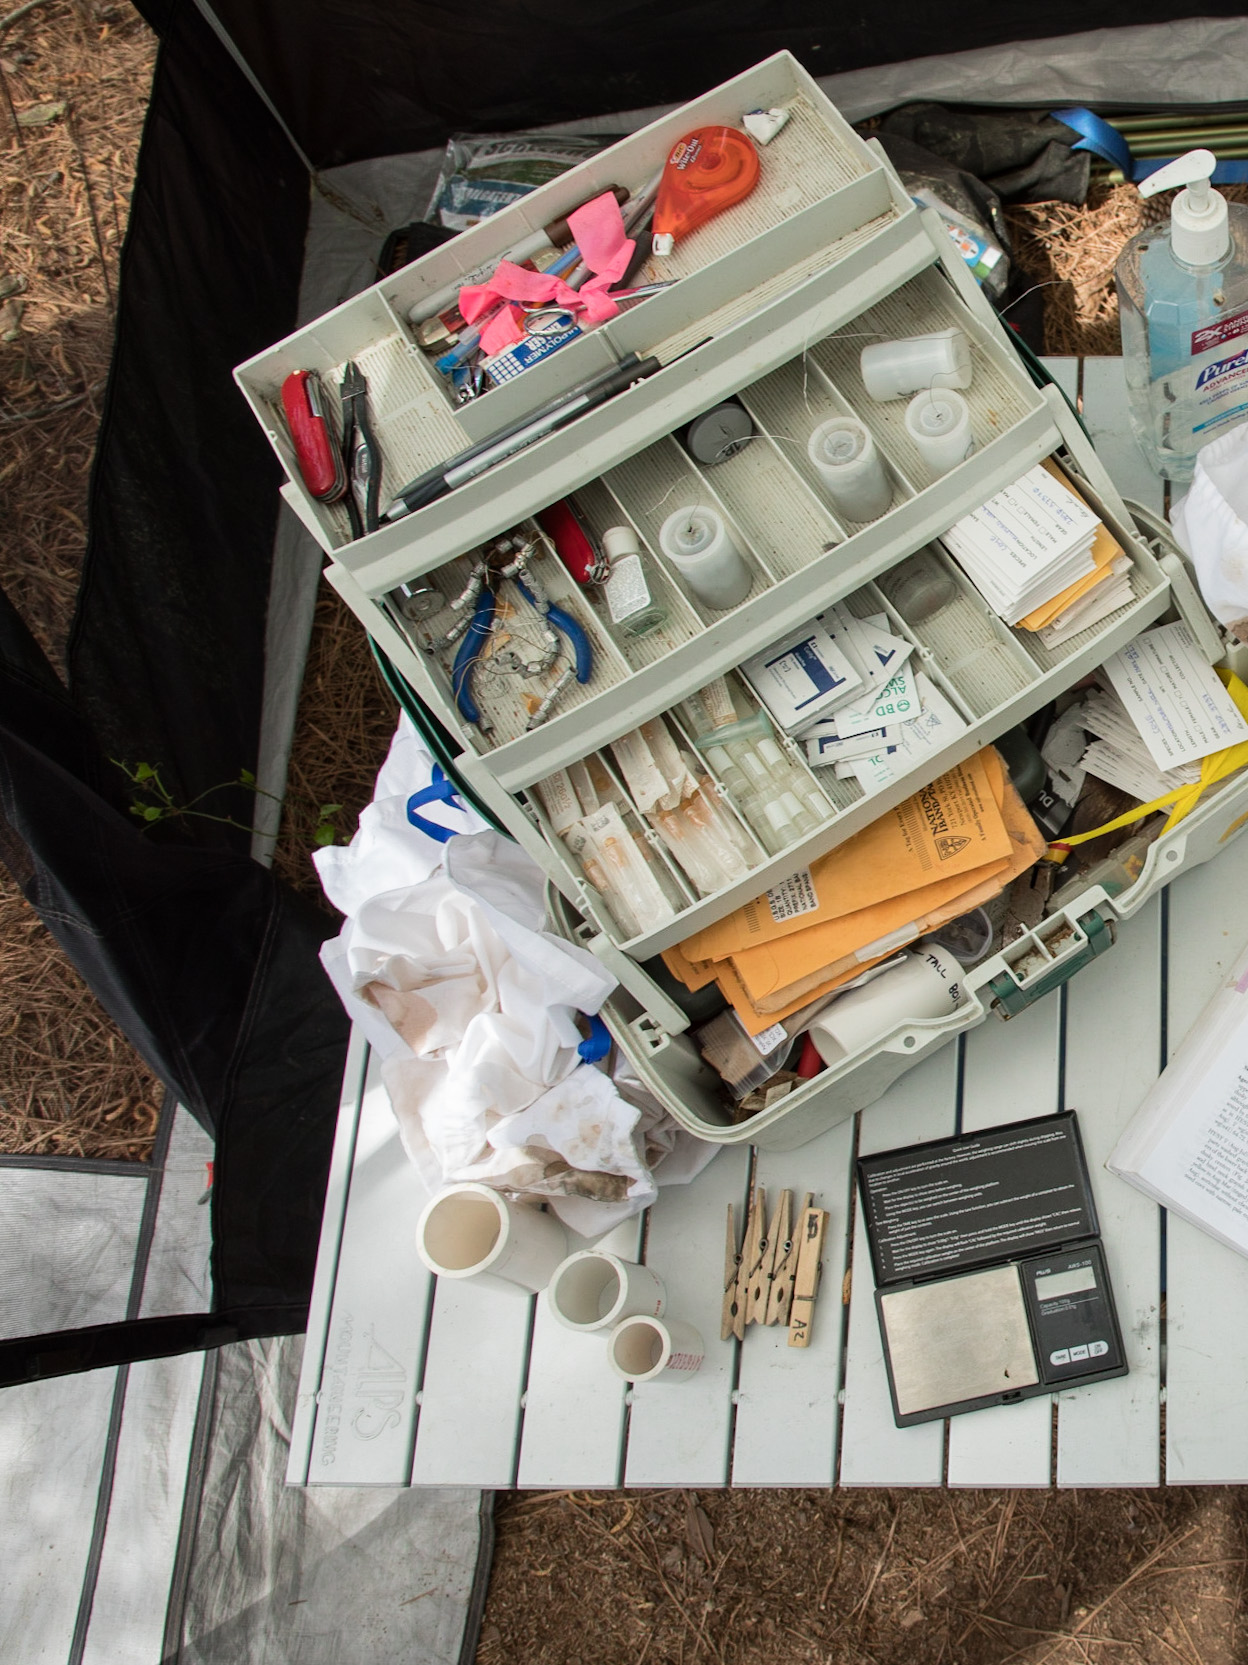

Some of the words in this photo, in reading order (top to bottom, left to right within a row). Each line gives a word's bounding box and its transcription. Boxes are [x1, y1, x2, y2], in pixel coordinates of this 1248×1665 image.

[1023, 510, 1040, 527] FEMALE
[1029, 534, 1047, 552] LENGTH
[1009, 550, 1027, 568] SPECIES
[1168, 654, 1186, 680] COLLECTOR
[874, 703, 895, 717] BD
[1185, 706, 1197, 724] FEMALE
[1161, 738, 1174, 756] SPECIES
[1170, 728, 1186, 752] LOCATION
[1184, 729, 1197, 747] LENGTH
[796, 882, 807, 910] NATIONAL
[807, 891, 816, 907] BAND
[923, 953, 951, 978] TALL
